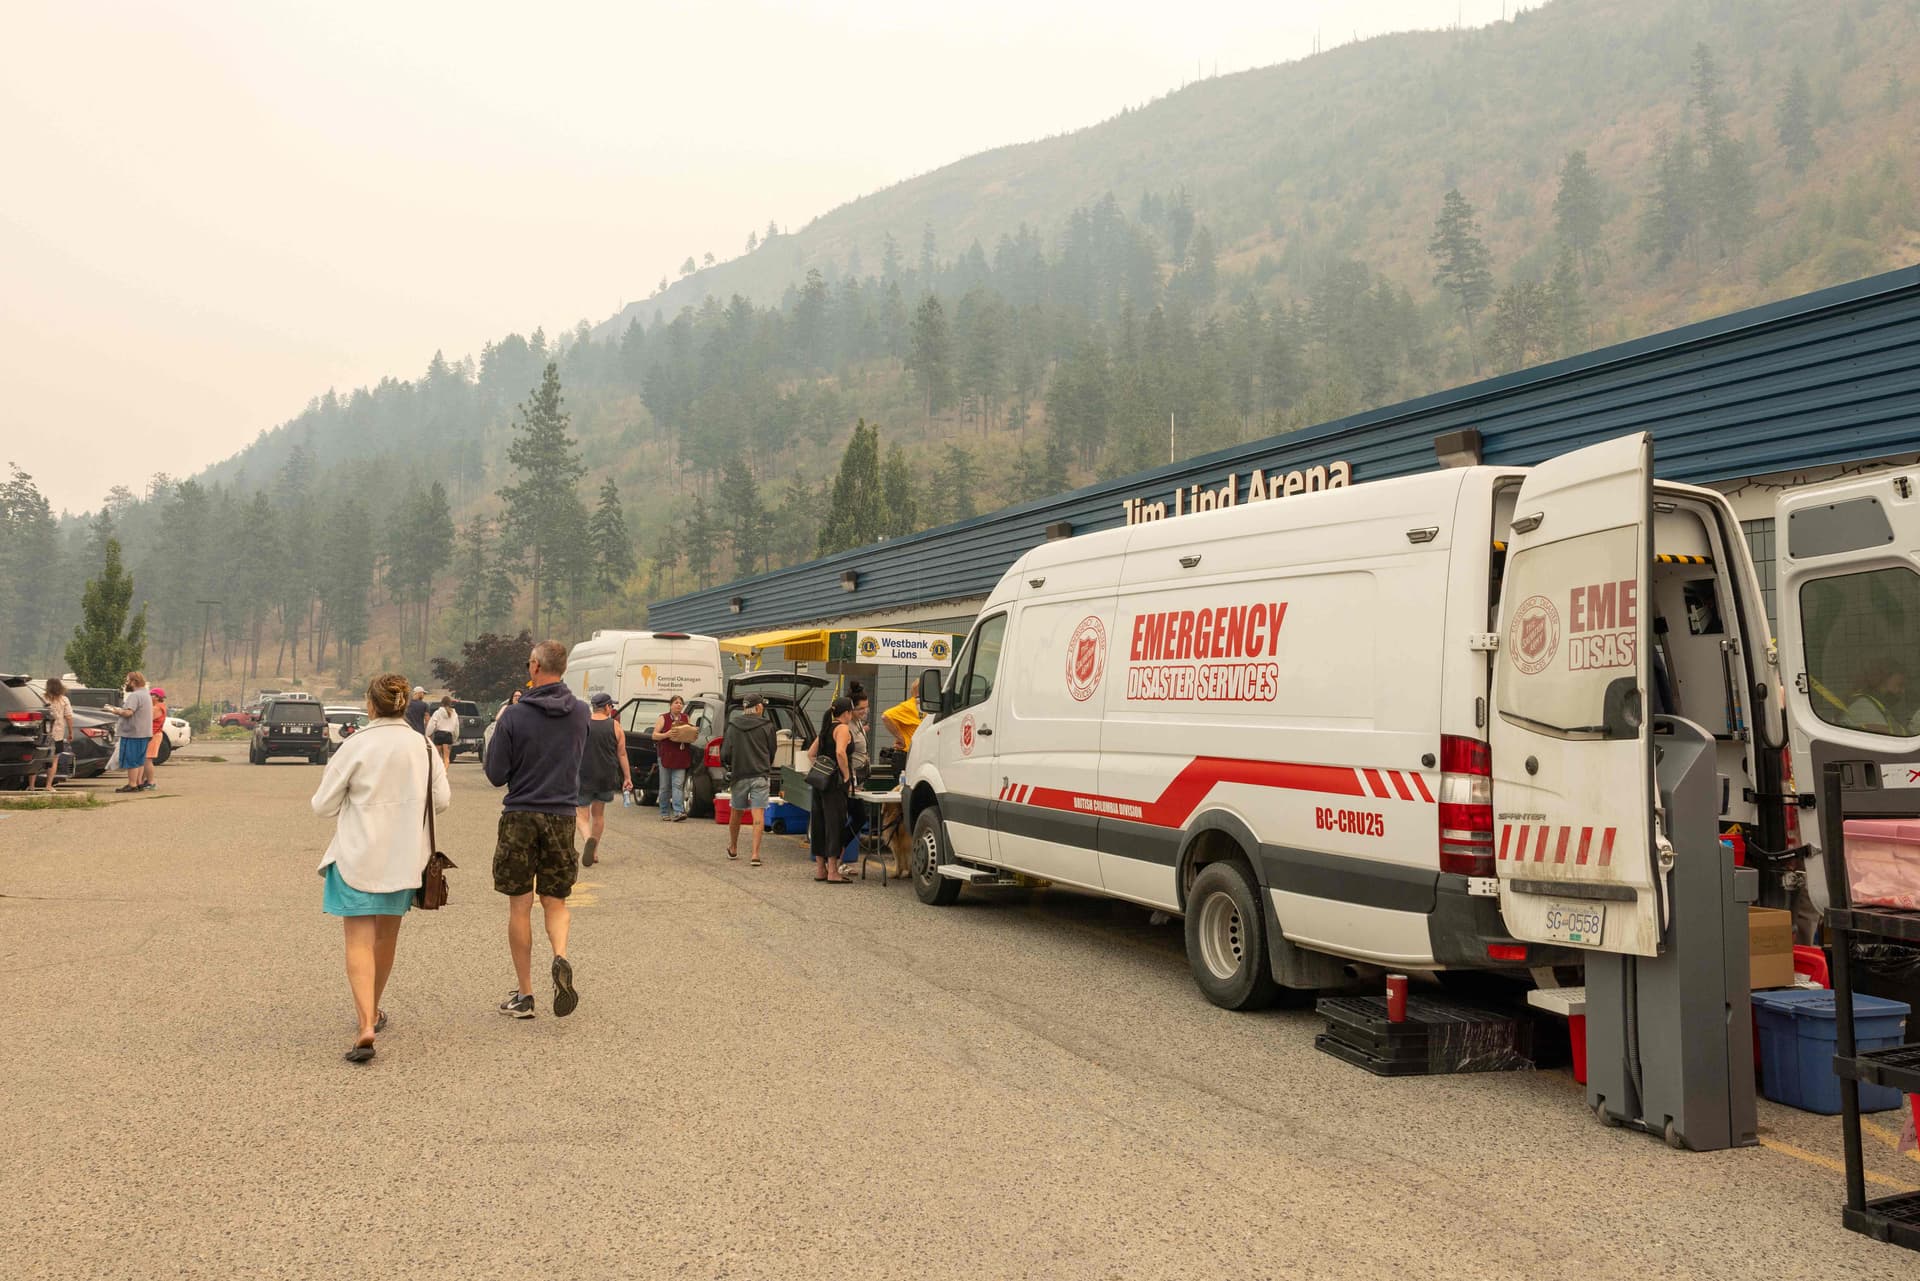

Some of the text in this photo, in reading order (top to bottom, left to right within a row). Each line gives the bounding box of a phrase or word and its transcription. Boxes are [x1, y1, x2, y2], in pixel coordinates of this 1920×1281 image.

[1248, 460, 1352, 503] Arena
[881, 638, 929, 649] Westbank
[1130, 602, 1288, 661] EMERGENCY
[892, 649, 918, 659] Lions
[1127, 662, 1279, 702] DISASTER SERVICES
[1315, 806, 1385, 838] BC-CRU25
